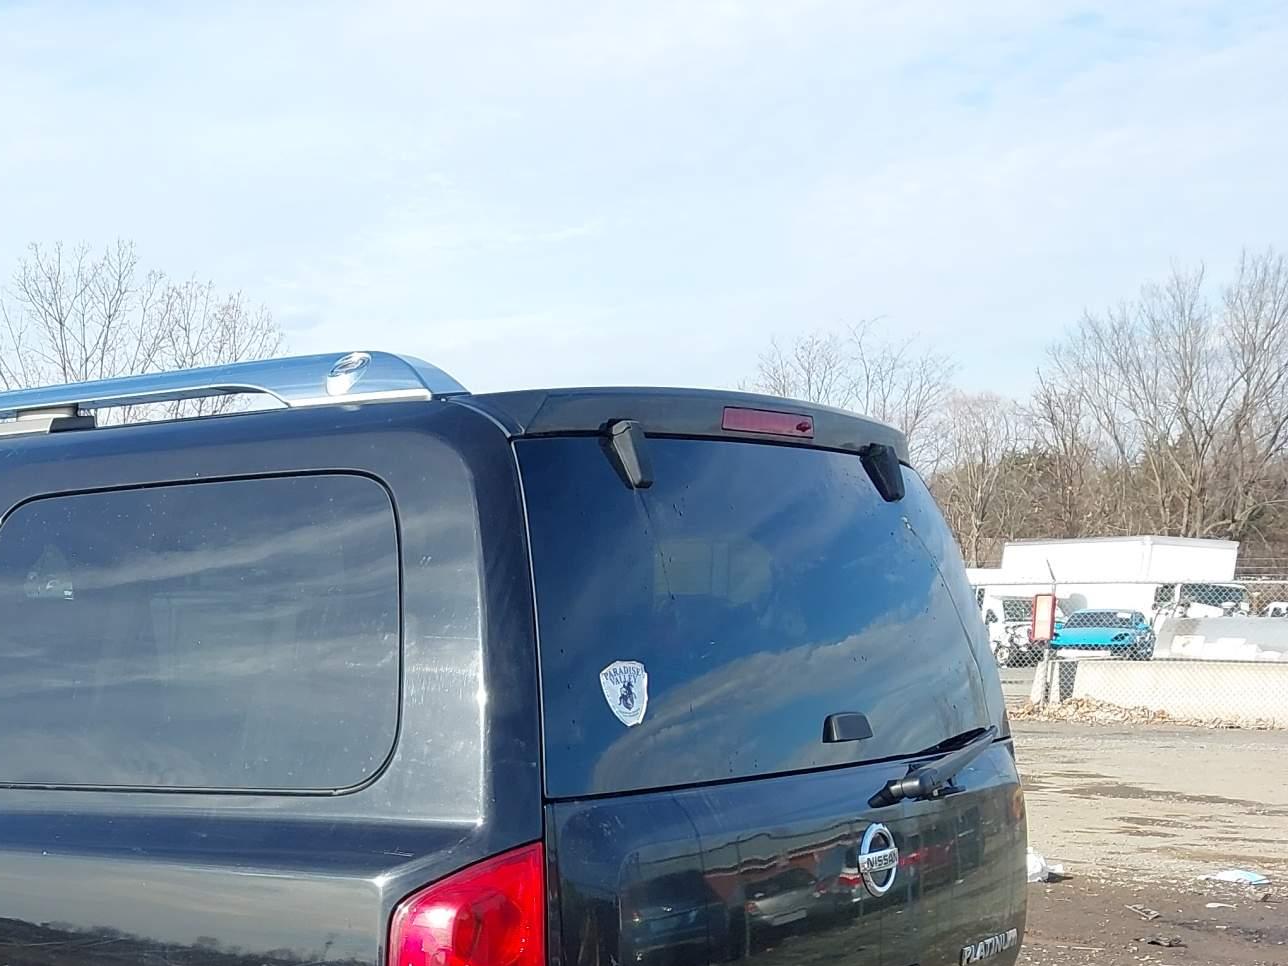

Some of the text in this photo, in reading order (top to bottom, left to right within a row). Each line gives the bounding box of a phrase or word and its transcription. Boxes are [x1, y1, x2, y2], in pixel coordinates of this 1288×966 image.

[603, 665, 642, 681] PARADISE
[610, 674, 638, 686] VALLEY
[866, 851, 899, 869] NISSAN
[959, 927, 1017, 966] PLATINUM
